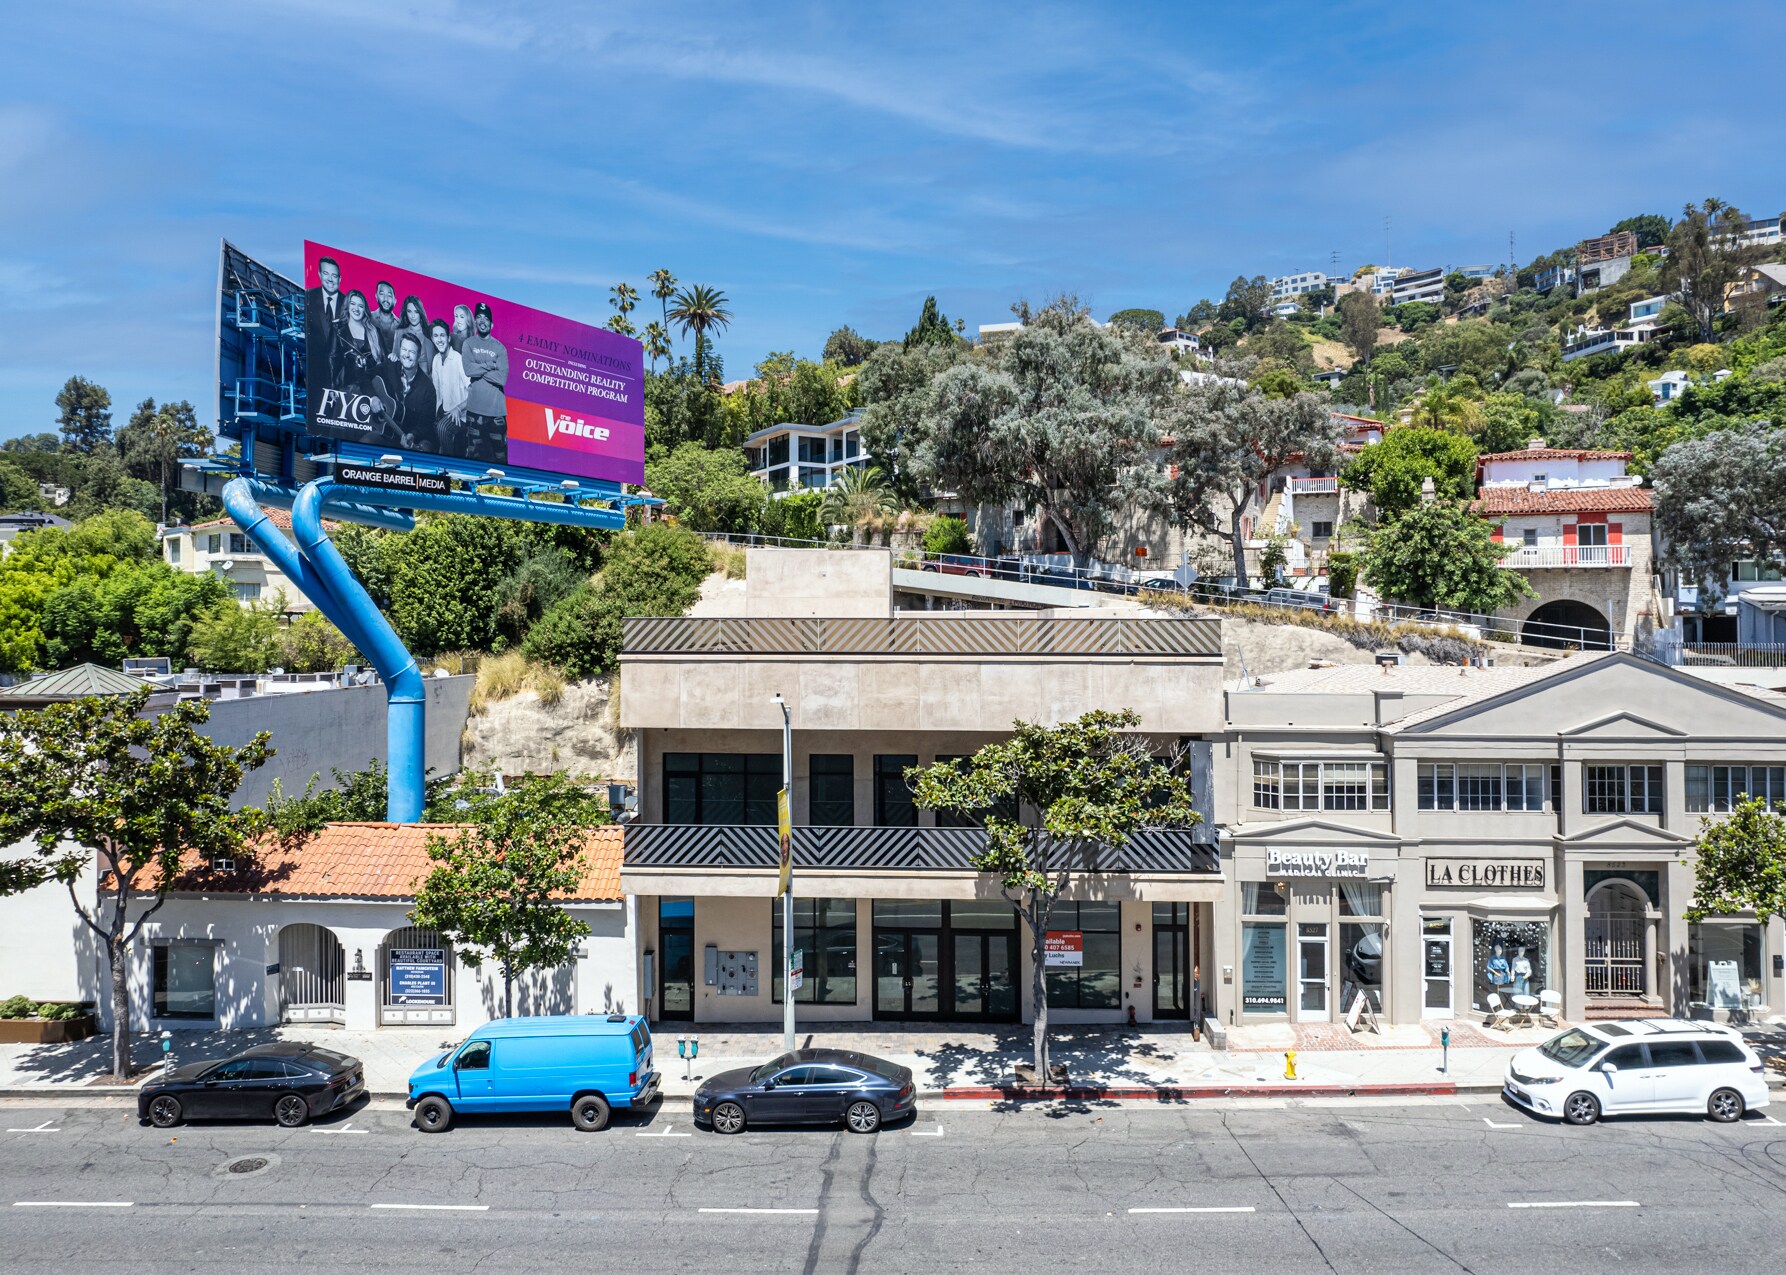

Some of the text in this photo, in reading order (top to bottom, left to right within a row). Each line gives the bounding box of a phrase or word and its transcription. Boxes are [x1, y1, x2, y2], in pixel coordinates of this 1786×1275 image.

[518, 333, 632, 371] 4 EMMY NOMINATIONS
[522, 370, 629, 404] COMPETITION PROGRAM
[525, 358, 626, 391] OUTSTANDING REALITY
[315, 387, 373, 424] FYC
[316, 417, 373, 431] CONSIDERWB.COM
[544, 407, 610, 441] Voice
[342, 468, 446, 490] ORANGE BARREL MEDIA
[1268, 848, 1369, 871] Beauty Bar
[1280, 869, 1359, 877] MEDICAL CLINIC
[1430, 864, 1543, 883] LA CLOTHES
